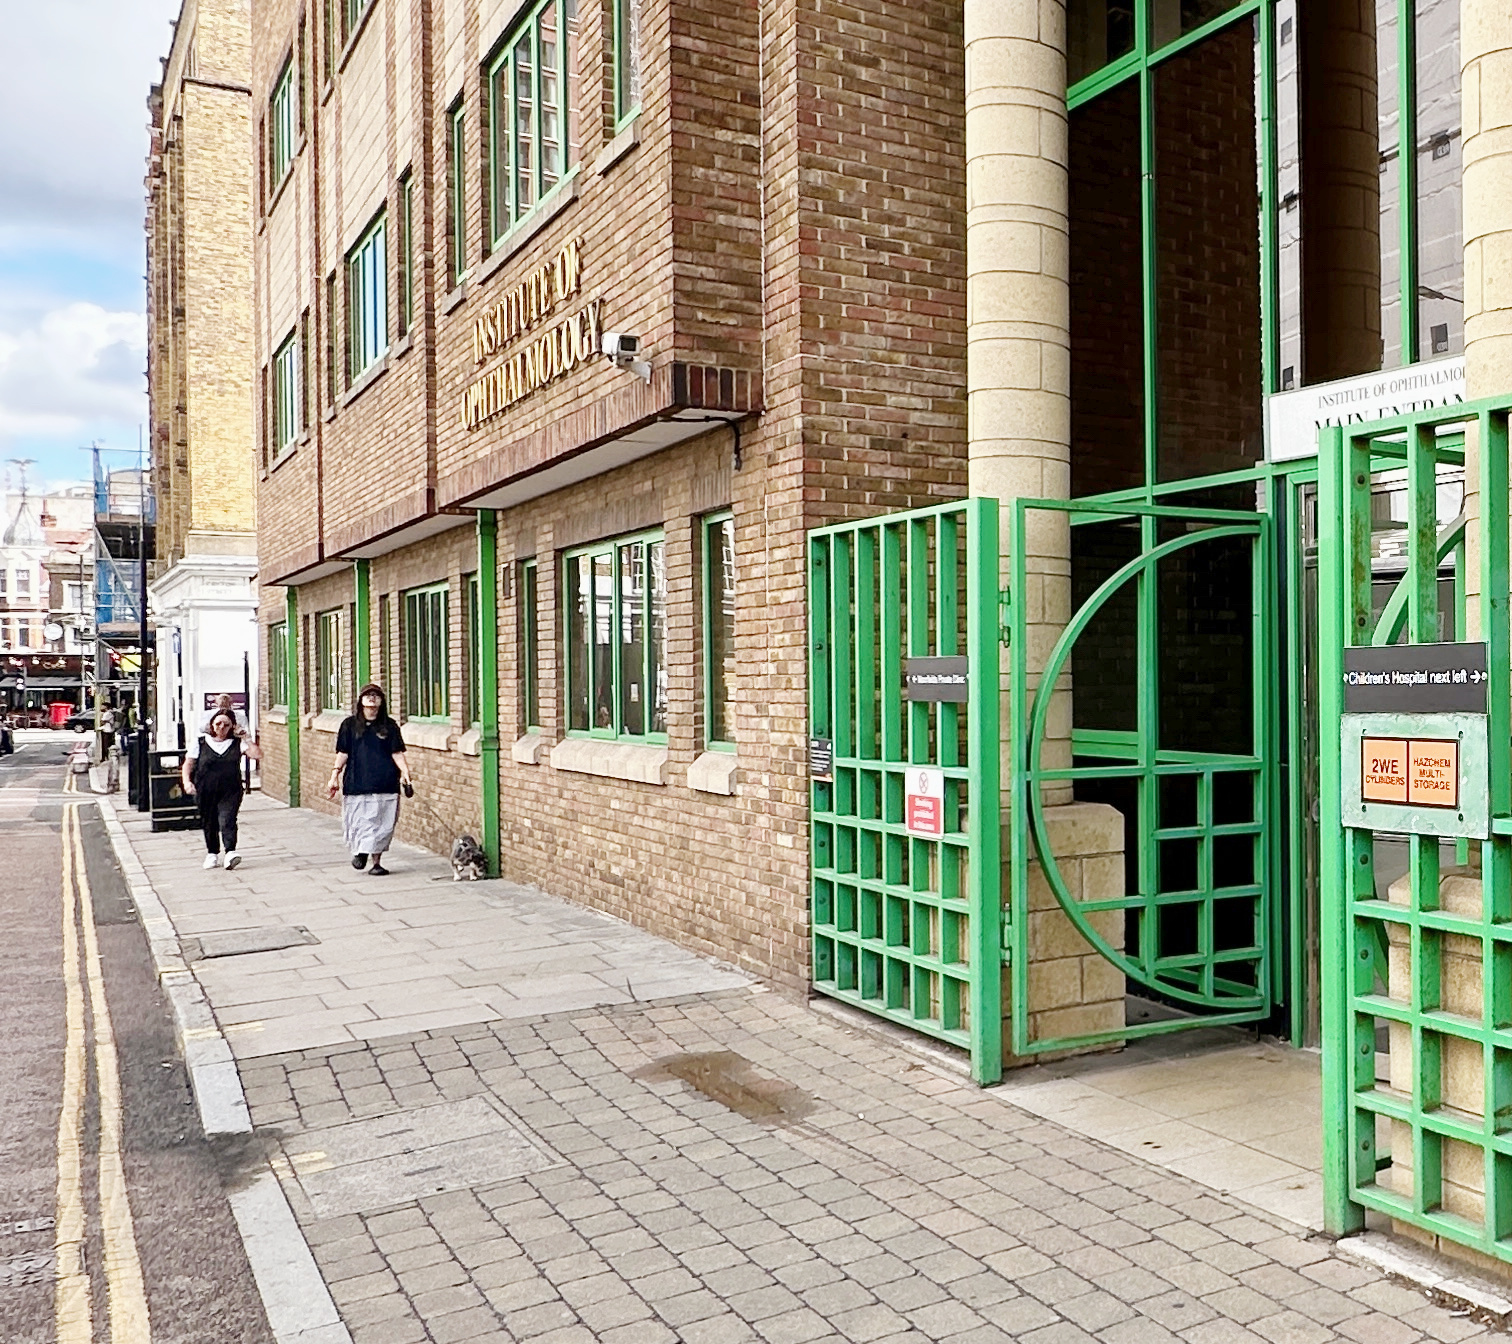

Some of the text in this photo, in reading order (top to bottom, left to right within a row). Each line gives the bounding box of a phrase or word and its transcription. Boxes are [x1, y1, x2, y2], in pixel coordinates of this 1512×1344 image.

[474, 237, 582, 365] INSTITUTE OF
[462, 298, 602, 430] OPHTHALMOLOGY
[1318, 386, 1370, 408] INSTITUTE
[1373, 381, 1387, 397] OF
[1390, 366, 1465, 394] OPHTHALMO
[1348, 668, 1468, 688] Children's Hospital next left
[1372, 758, 1399, 775] 2WE
[1413, 757, 1451, 768] HAZCHEM
[1413, 778, 1451, 791] STORAGE
